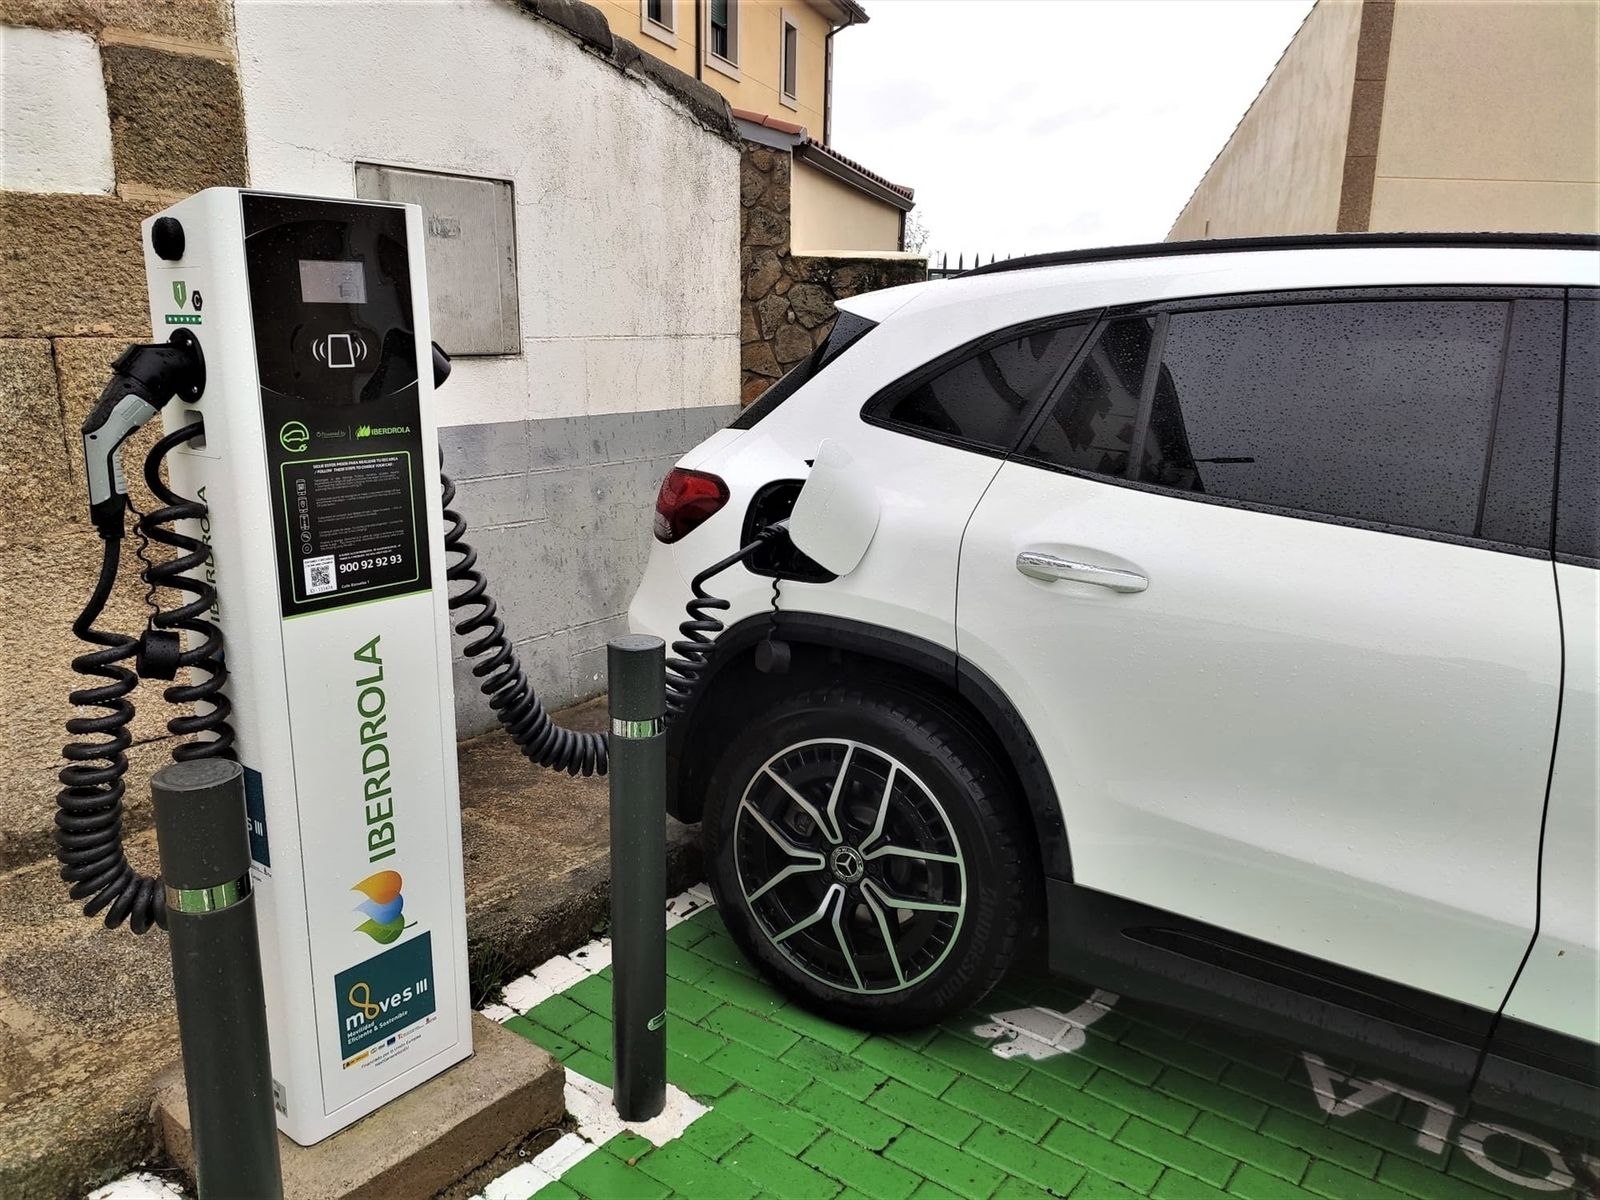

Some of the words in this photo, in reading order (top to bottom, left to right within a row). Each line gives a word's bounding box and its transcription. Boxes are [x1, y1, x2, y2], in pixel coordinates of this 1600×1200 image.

[371, 426, 411, 436] IBERDROLA
[340, 561, 359, 573] 900
[361, 559, 374, 570] 92
[375, 556, 388, 567] 92
[389, 554, 402, 565] 93
[353, 634, 397, 863] IBERDROLA
[347, 1029, 373, 1045] Eficiente
[379, 1010, 409, 1029] Sostenible
[347, 1020, 375, 1039] Movilidad
